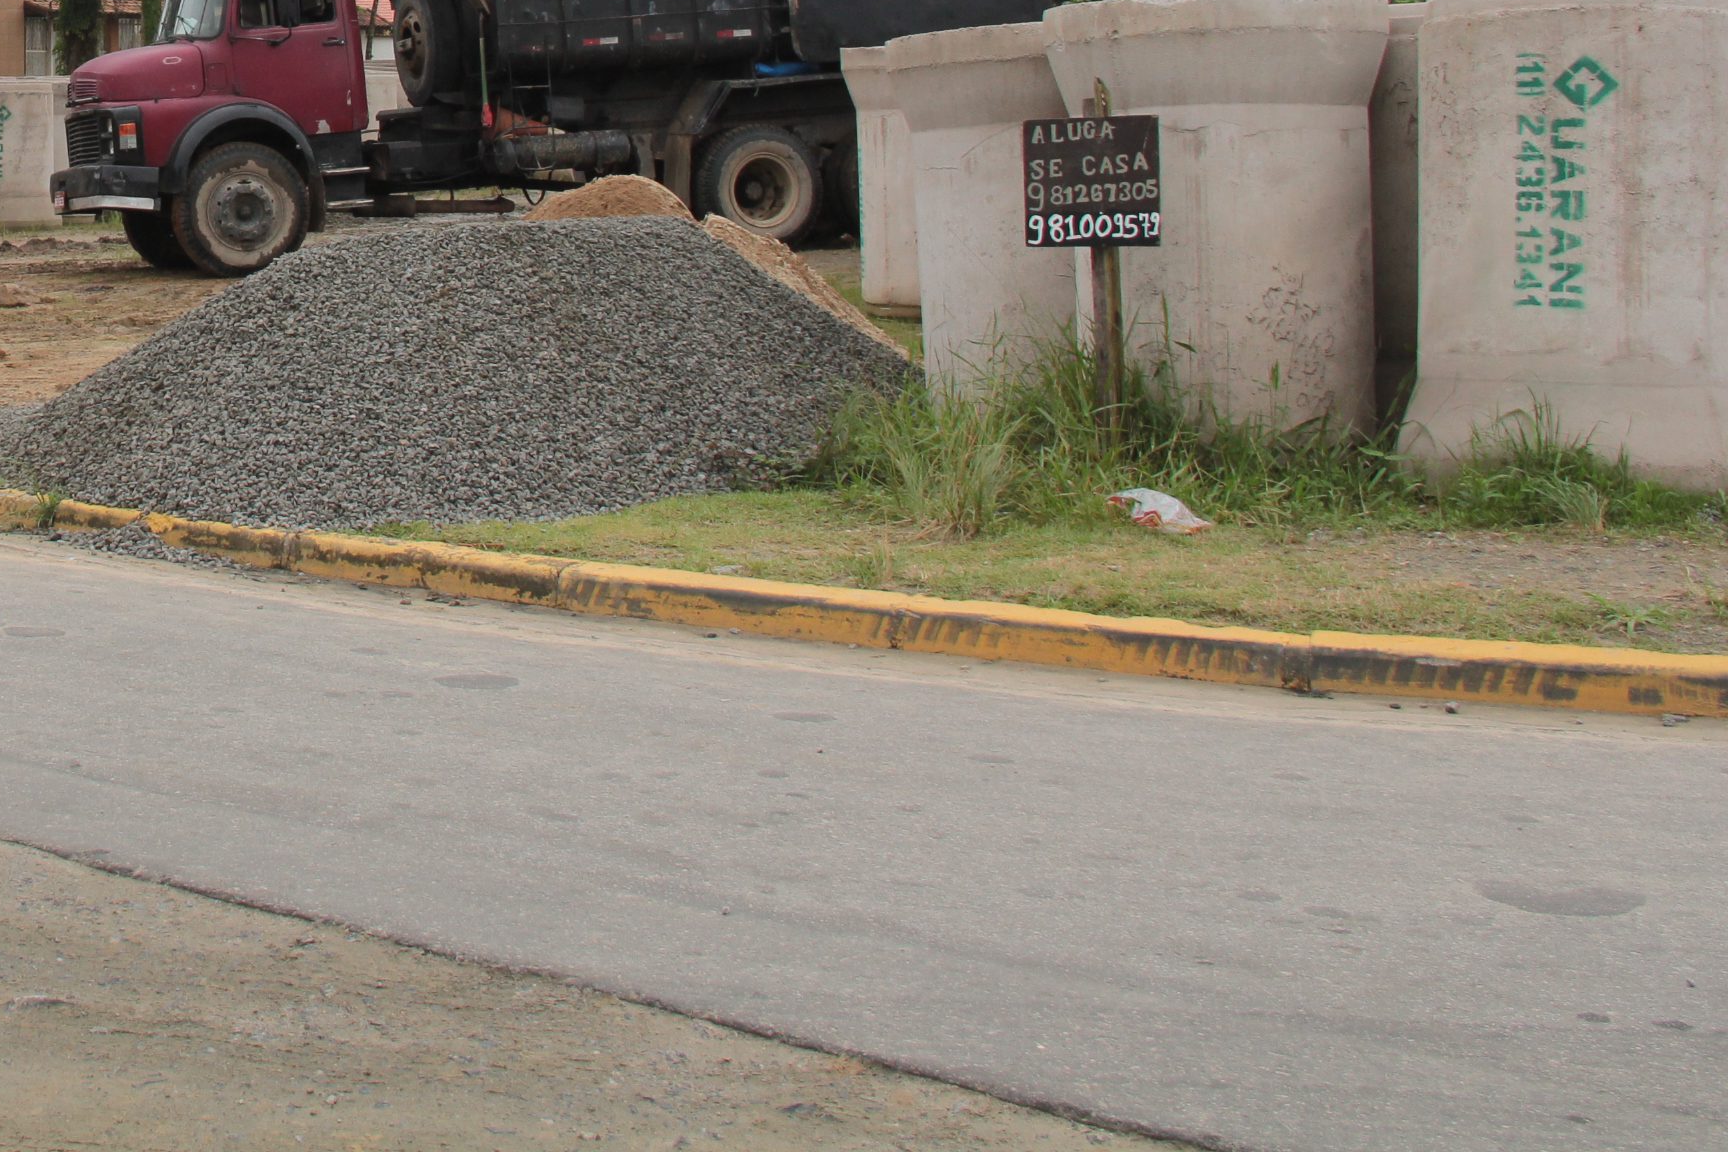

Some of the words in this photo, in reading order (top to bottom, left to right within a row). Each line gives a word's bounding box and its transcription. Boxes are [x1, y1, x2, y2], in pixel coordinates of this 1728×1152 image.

[1515, 52, 1546, 97] (11)
[1032, 120, 1115, 144] ALUGA
[1030, 158, 1063, 180] SE
[1082, 151, 1149, 176] CASA
[1513, 114, 1546, 308] 2436.1341
[1027, 212, 1160, 245] 981009579
